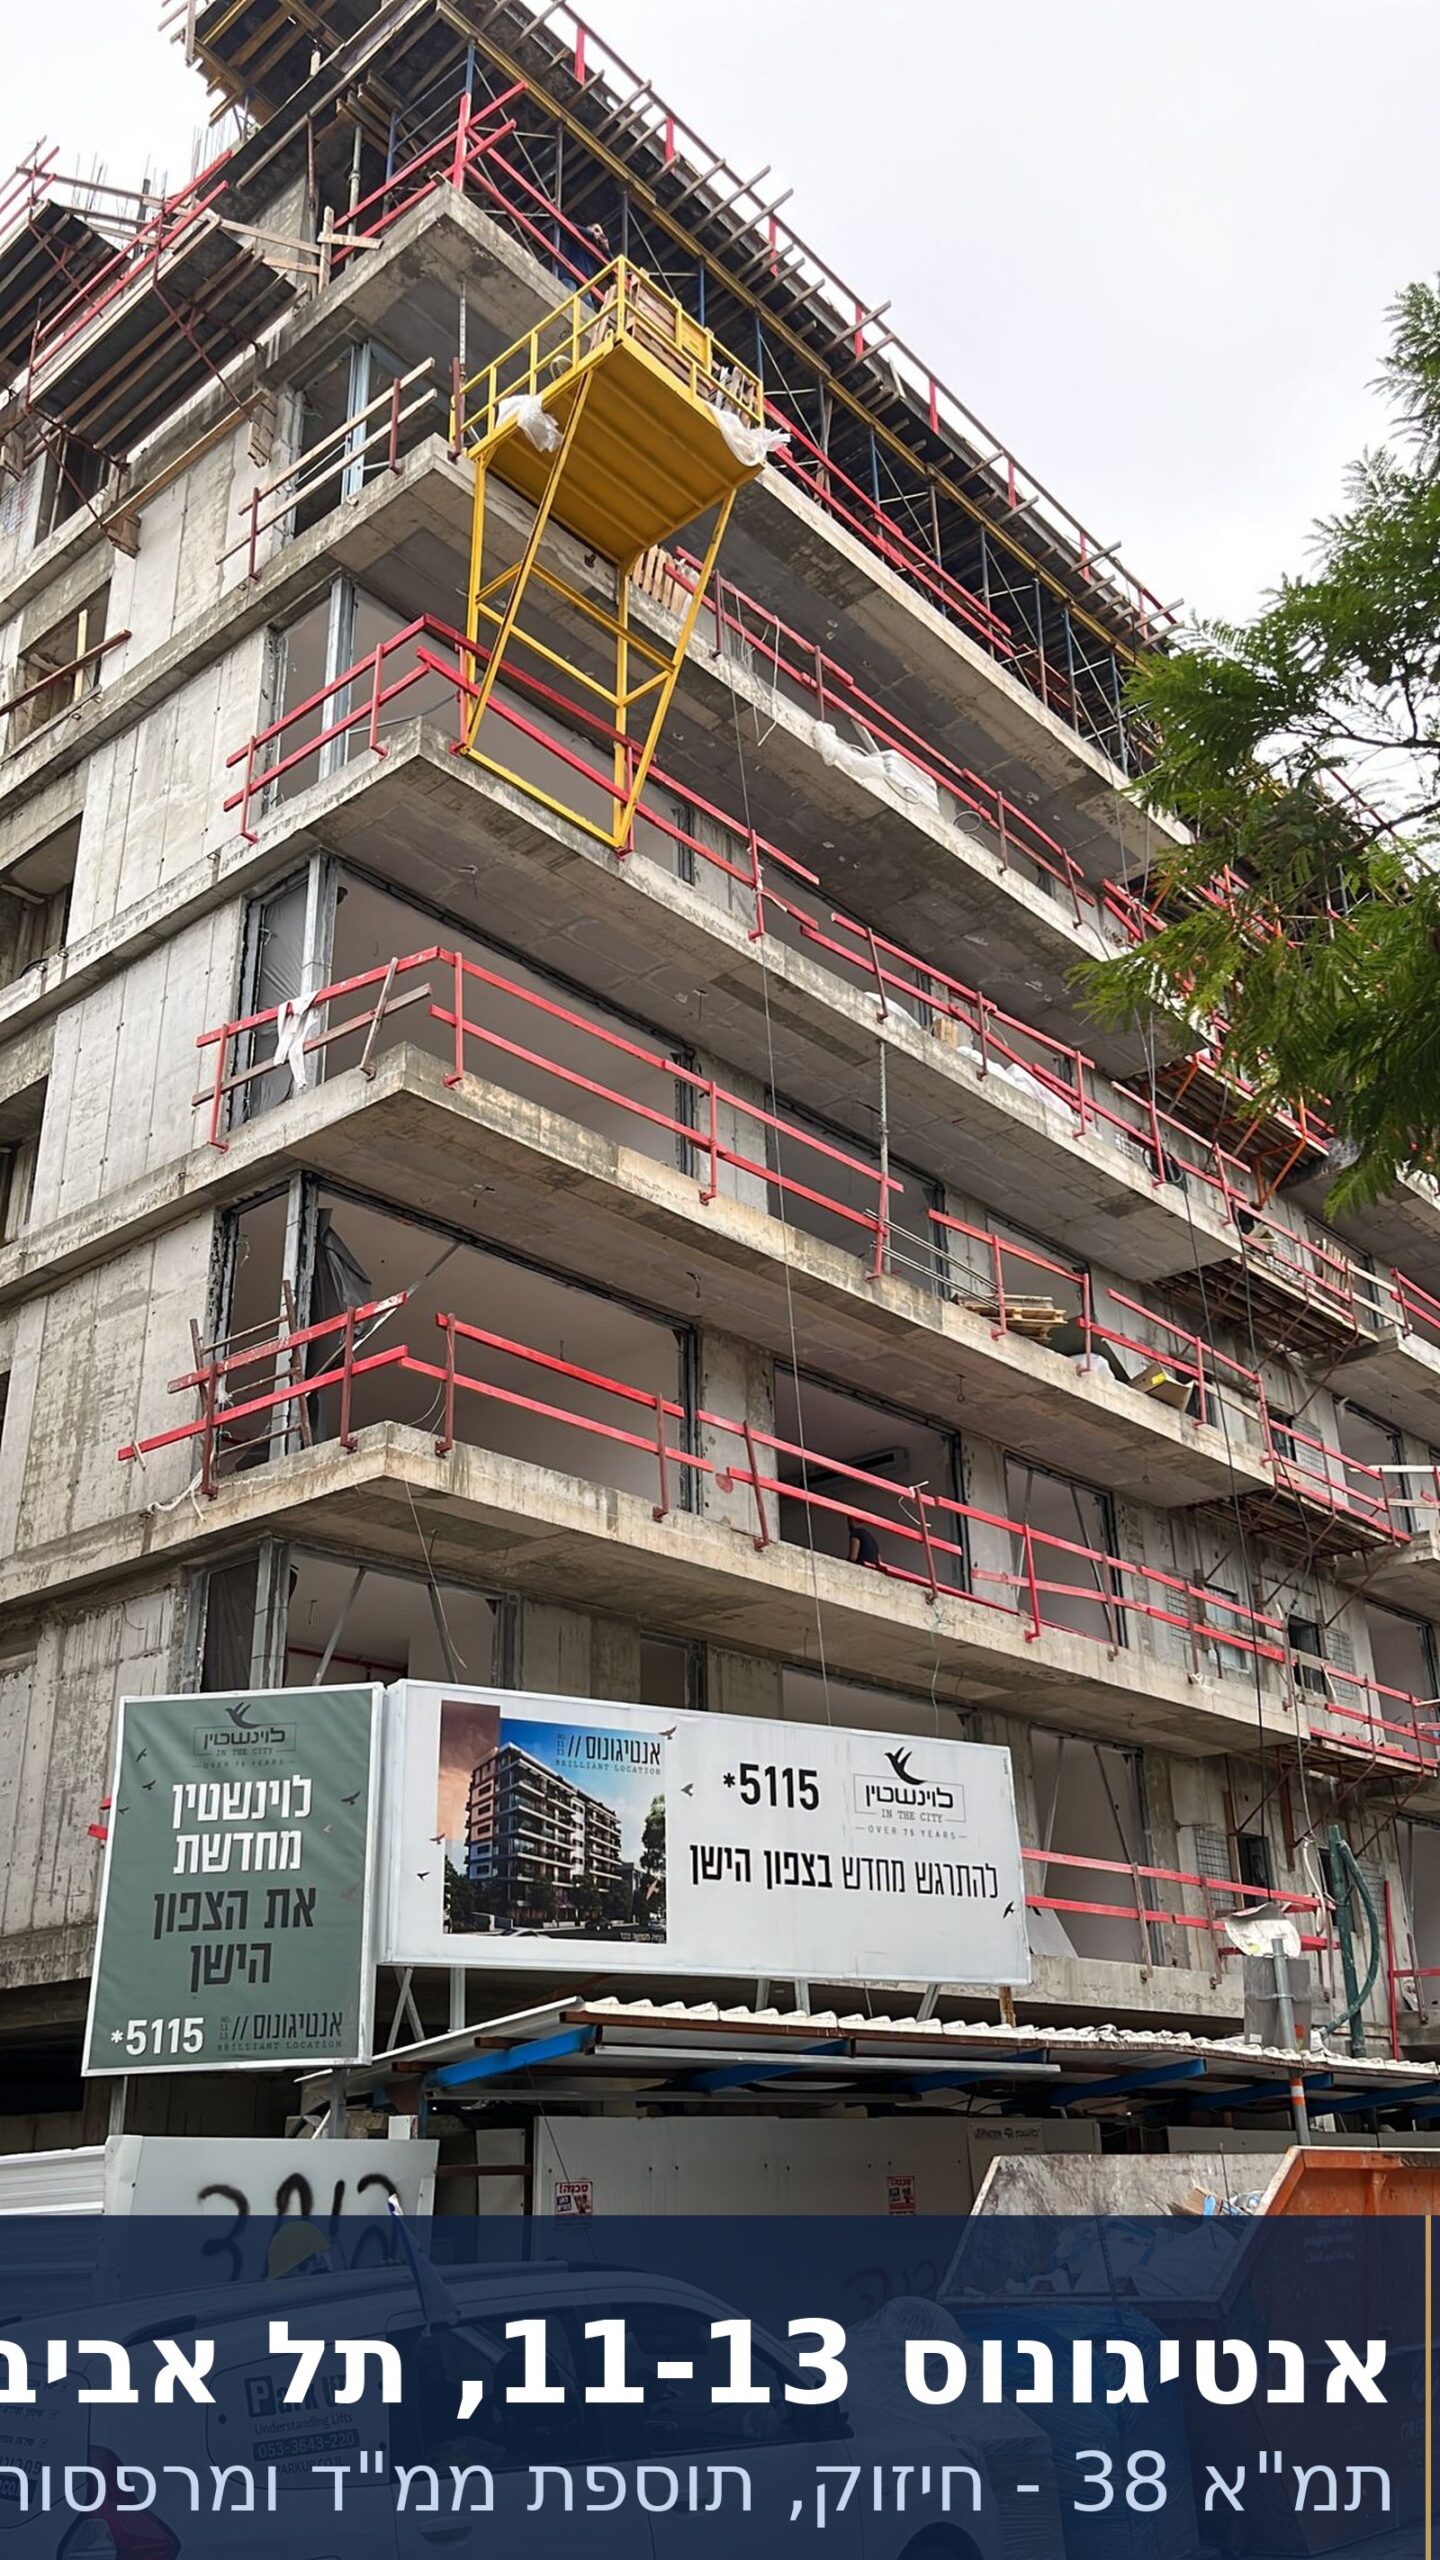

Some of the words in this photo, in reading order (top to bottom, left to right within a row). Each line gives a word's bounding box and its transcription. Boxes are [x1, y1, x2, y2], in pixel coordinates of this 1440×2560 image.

[204, 1727, 286, 1750] לוינשטין
[252, 1747, 273, 1756] CITY
[586, 1736, 661, 1766] אנטיגונוס
[614, 1764, 661, 1775] LOCATION
[172, 1774, 312, 1829] לוינשטין
[865, 1785, 954, 1809] לוינשטין
[881, 1808, 893, 1819] IN
[897, 1810, 916, 1821] THE
[920, 1812, 943, 1823] CITY
[868, 1825, 897, 1835] OVER
[921, 1830, 956, 1840] YEARS
[174, 1831, 302, 1874] מחדשת
[689, 1844, 751, 1885] הישן
[763, 1849, 833, 1890] בצפון
[842, 1856, 905, 1893] מחדש
[914, 1860, 999, 1899] להתרגש
[153, 1890, 249, 1940] הצפון
[263, 1887, 317, 1930] את
[190, 1943, 273, 1993] הישן
[254, 2012, 343, 2039] אנטיגונוס
[217, 2042, 280, 2052] BRILLIANT
[285, 2040, 342, 2049] LOCATION
[254, 2416, 330, 2435] Understanding
[331, 2412, 353, 2425] Lifts
[257, 2431, 355, 2459] 053-3643-220
